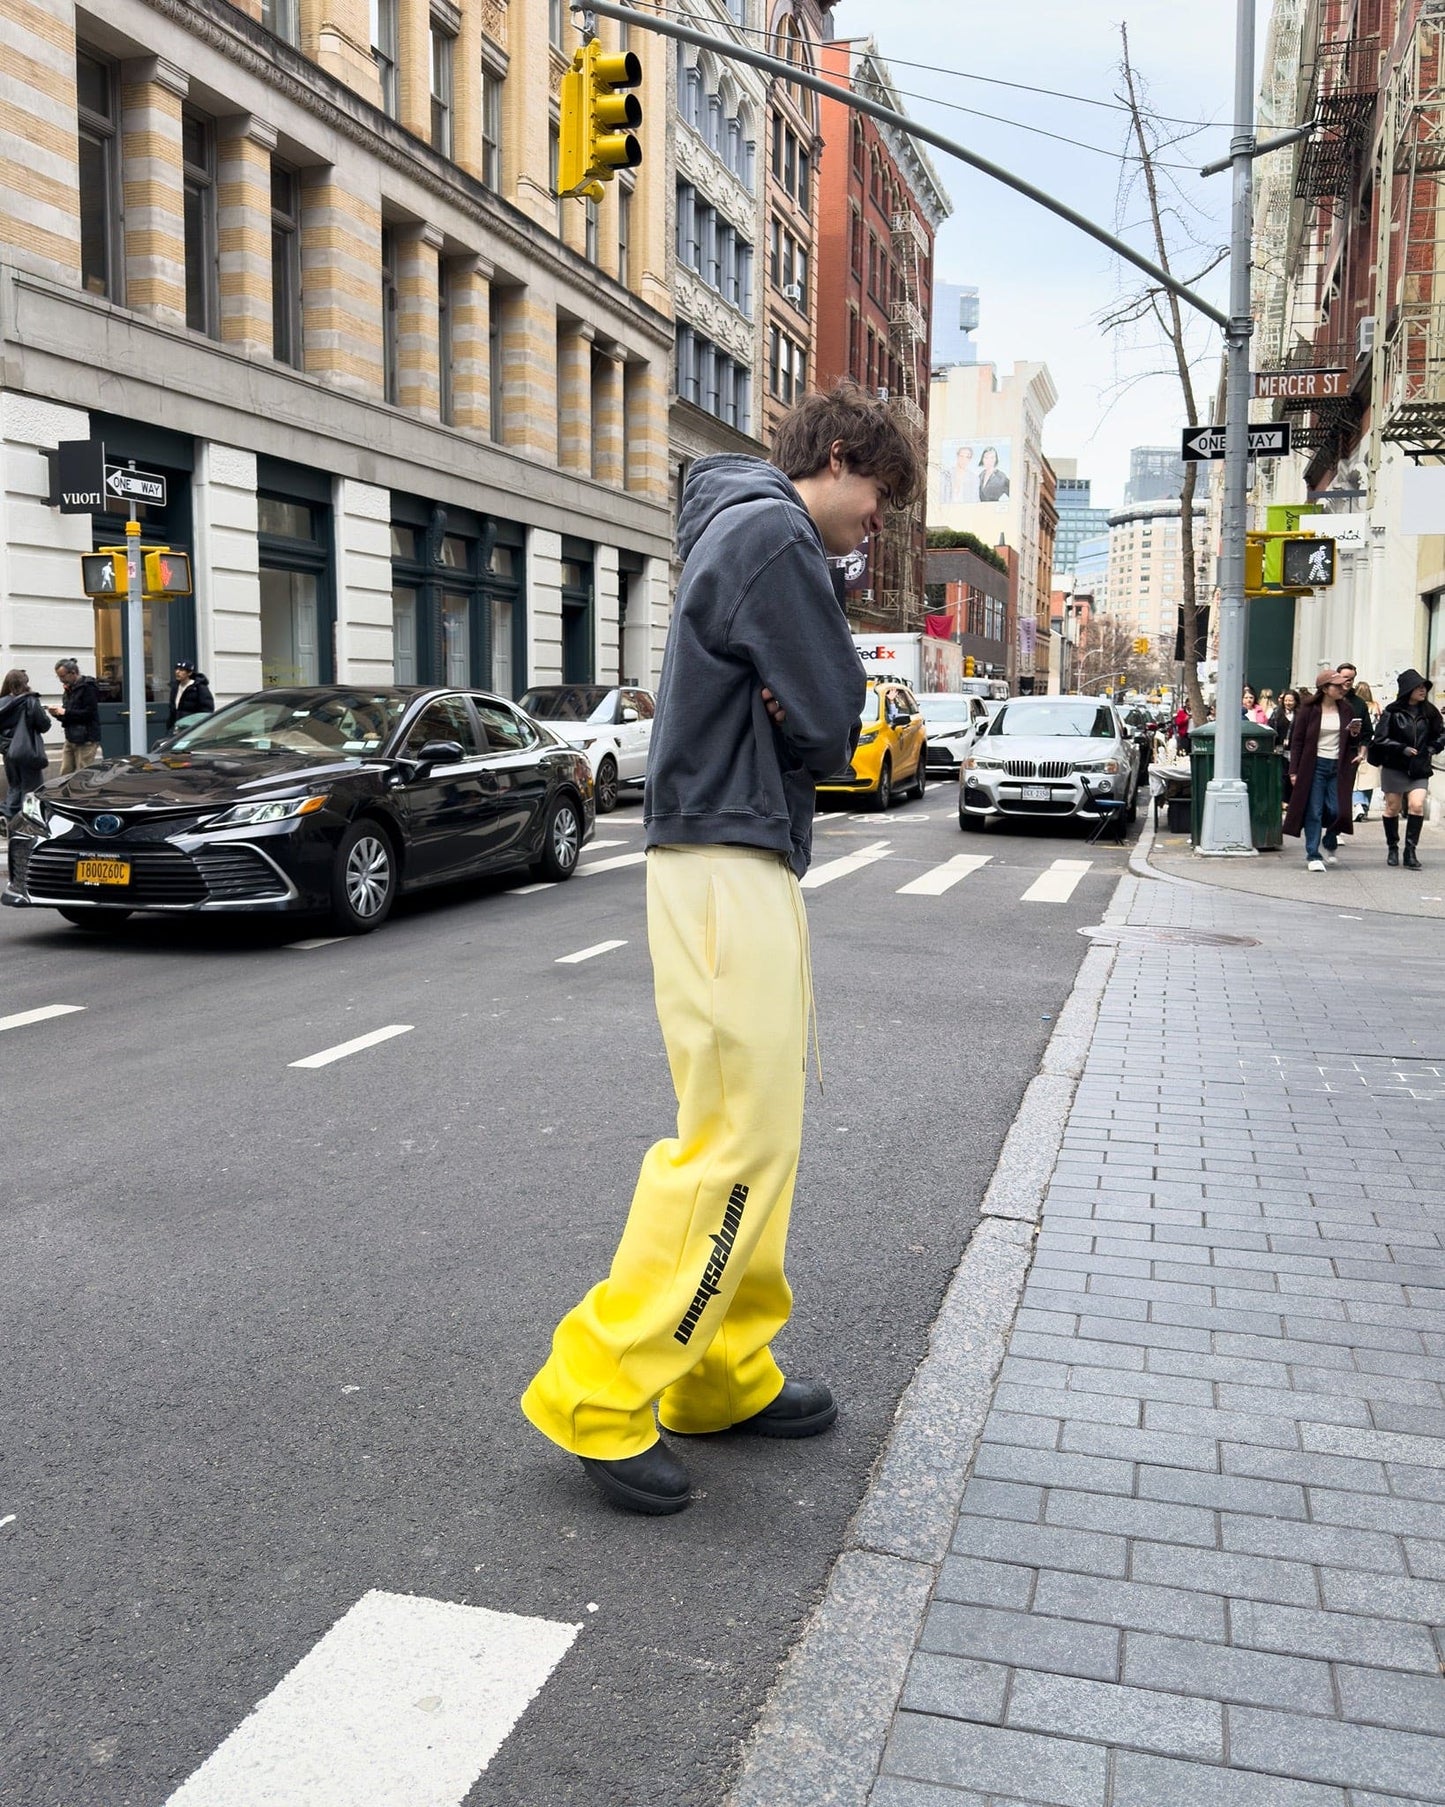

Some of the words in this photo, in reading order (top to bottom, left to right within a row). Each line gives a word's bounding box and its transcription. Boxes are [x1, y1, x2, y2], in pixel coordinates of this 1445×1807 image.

[1258, 375, 1315, 397] MERCER
[1323, 374, 1341, 394] ST
[1198, 436, 1226, 450] ONE
[113, 476, 132, 491] ONE
[141, 482, 160, 495] WAY
[62, 492, 101, 505] vuori
[80, 862, 125, 879] T800260C
